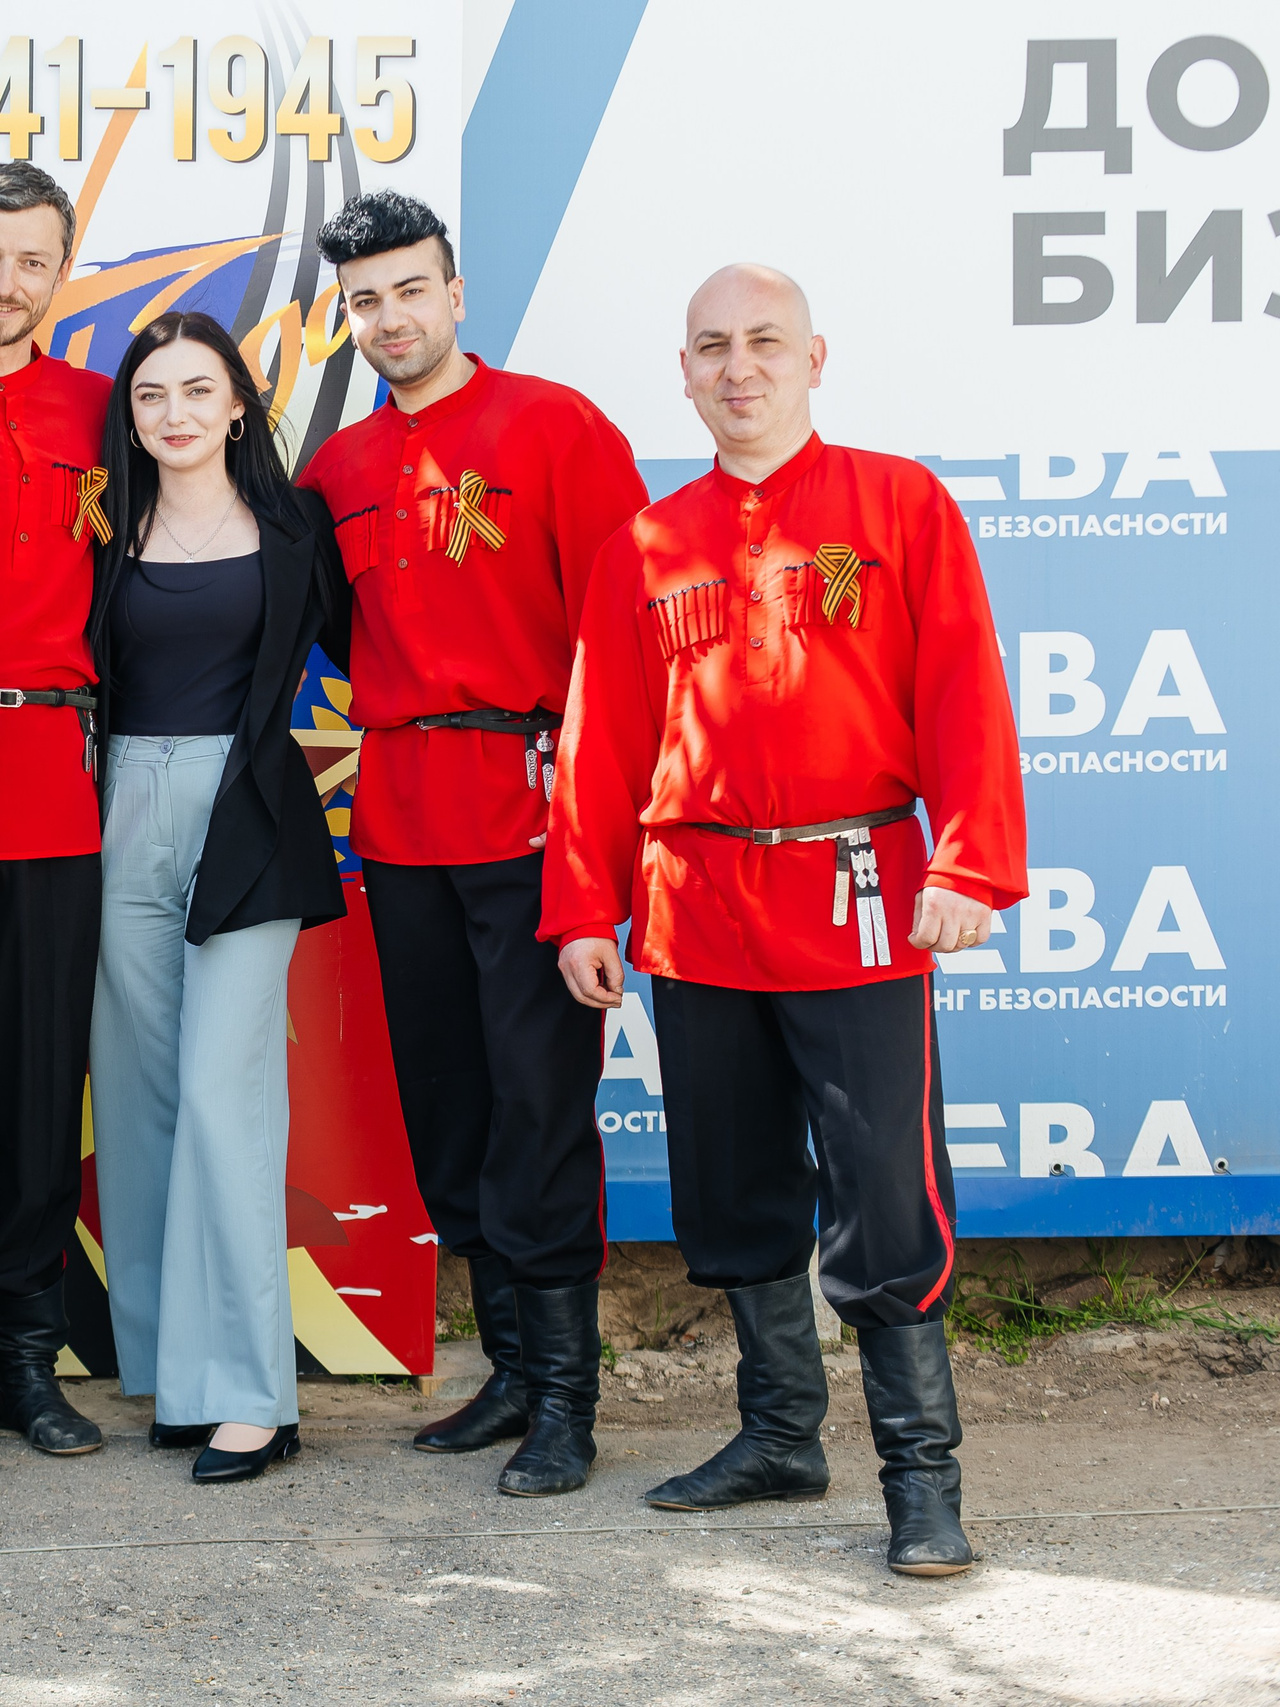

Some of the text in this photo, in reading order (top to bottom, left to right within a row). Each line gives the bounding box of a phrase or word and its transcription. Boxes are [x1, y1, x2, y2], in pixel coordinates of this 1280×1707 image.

[1003, 34, 1271, 176] ДО
[1012, 209, 1280, 326] БИ
[978, 512, 1228, 539] БЕЗОПАСНОСТИ
[995, 629, 1228, 738] ВА
[979, 985, 1228, 1012] БЕЗОПАСНОСТИ
